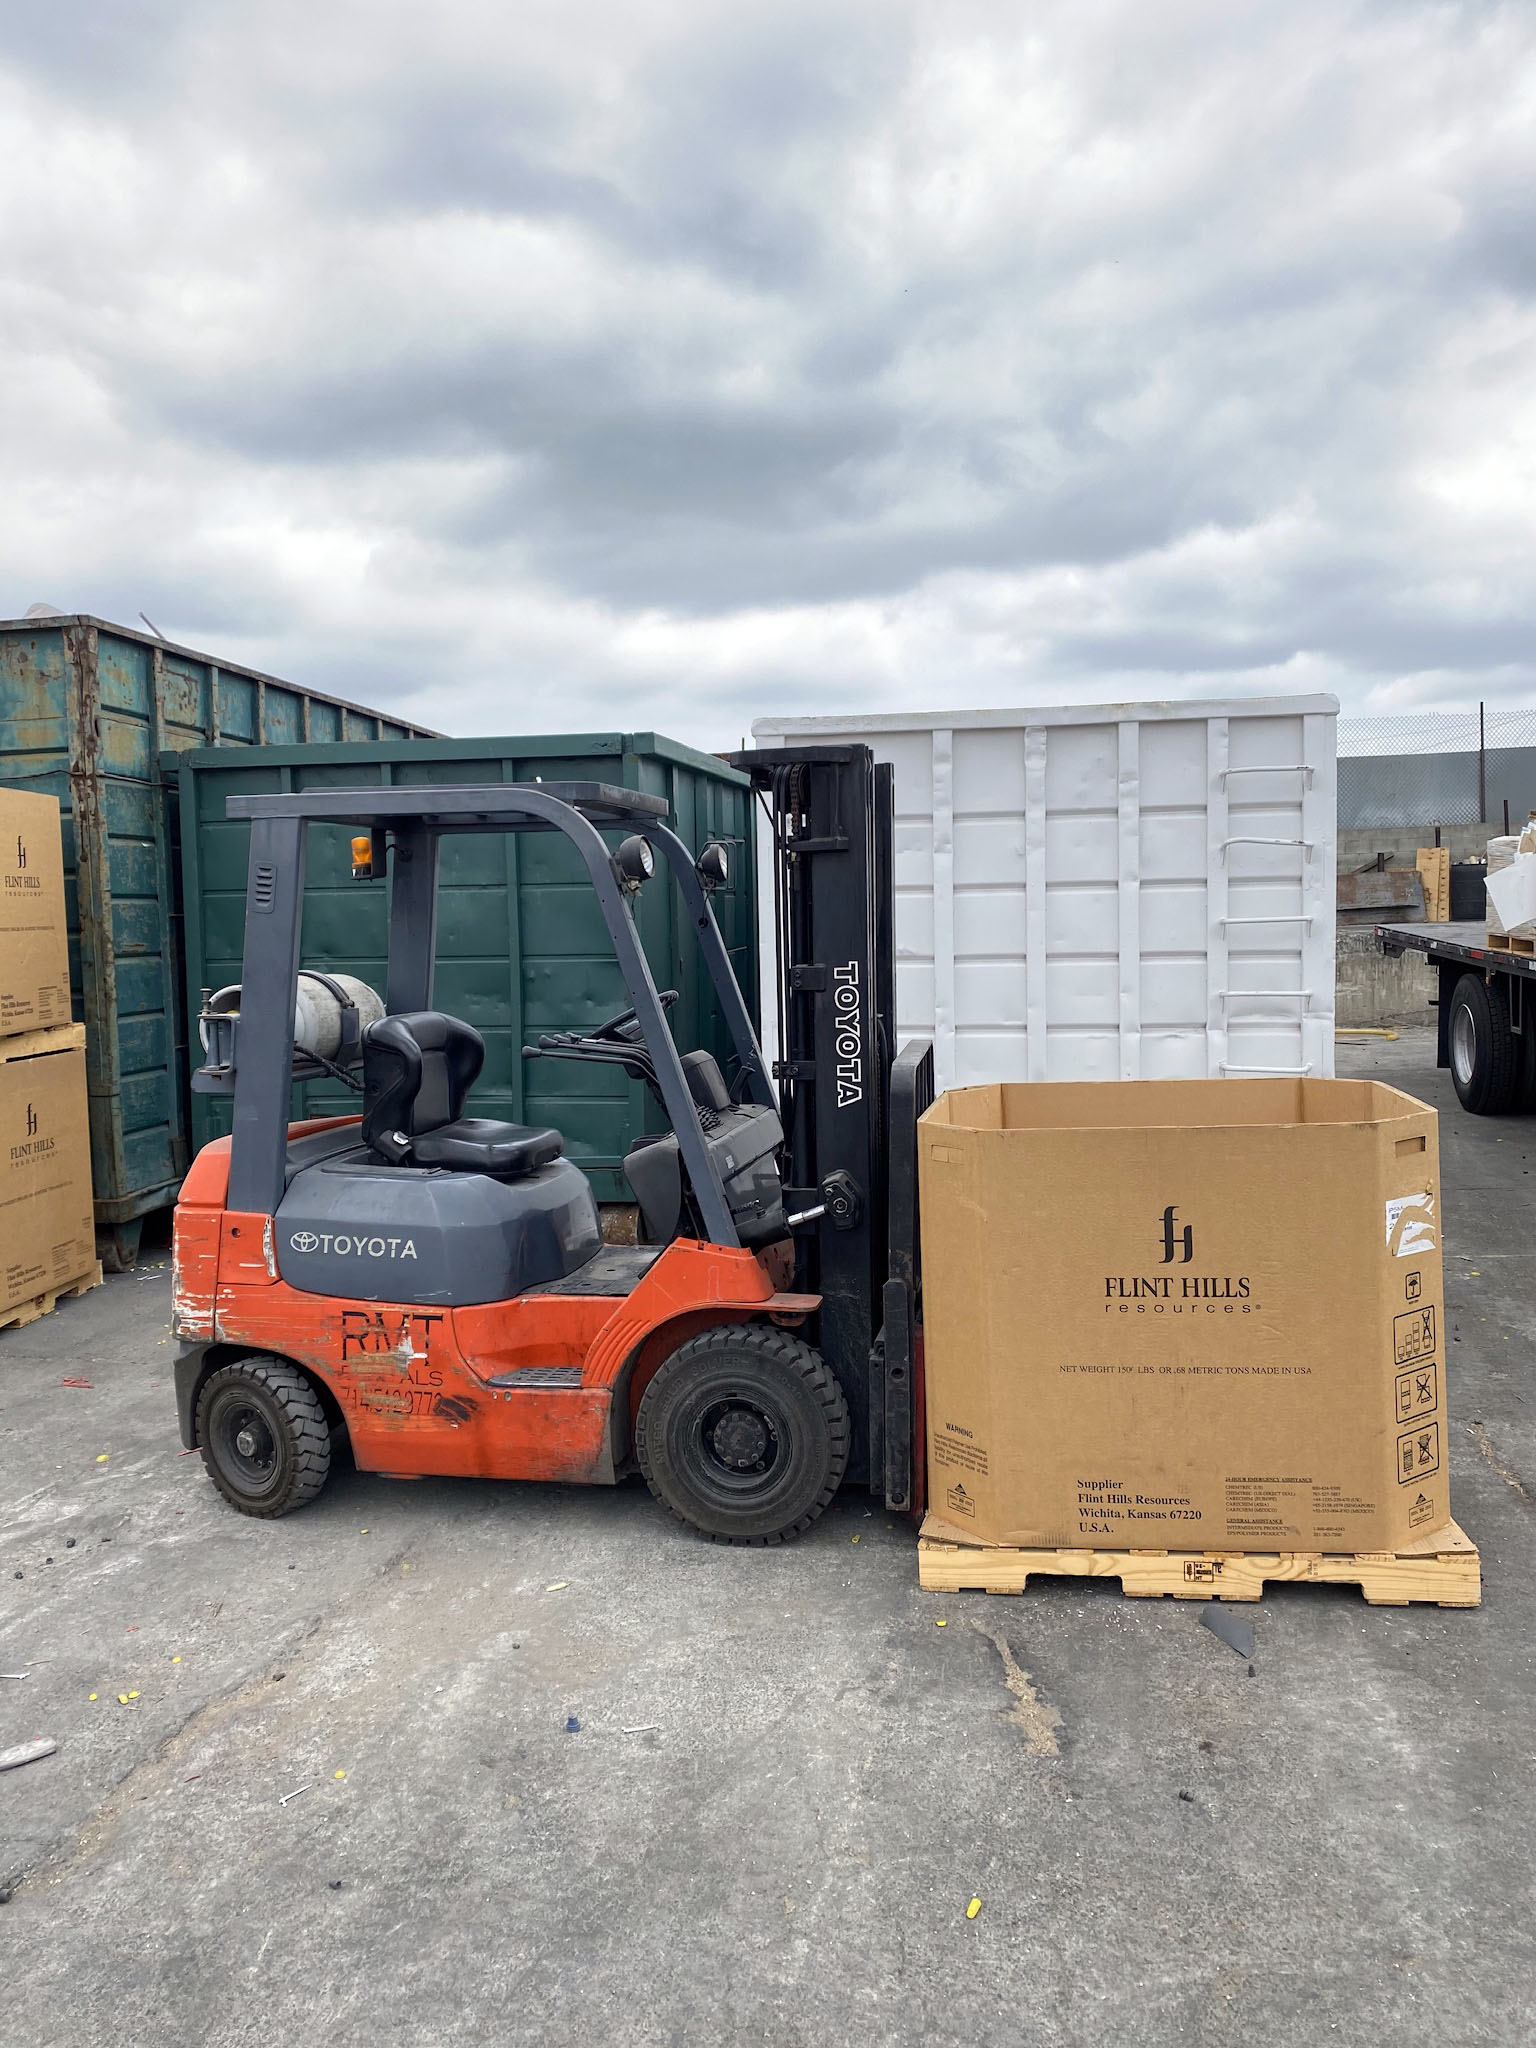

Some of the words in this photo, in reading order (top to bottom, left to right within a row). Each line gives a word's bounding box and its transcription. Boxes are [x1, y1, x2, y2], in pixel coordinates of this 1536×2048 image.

[4, 875, 22, 888] FLINT
[833, 960, 863, 1108] TOYOTA
[10, 1143, 32, 1160] FLINT
[33, 1137, 55, 1153] HILLS
[319, 1234, 418, 1260] TOYOTA
[1104, 1277, 1174, 1298] FLINT
[1180, 1277, 1250, 1298] HILLS
[1059, 1365, 1078, 1373] NET
[1079, 1365, 1115, 1374] WEIGHT
[1137, 1365, 1155, 1374] LBS
[1158, 1365, 1172, 1374] OR
[1188, 1366, 1223, 1374] METRIC
[1225, 1366, 1250, 1374] TONS
[1251, 1366, 1280, 1374] MADE
[1281, 1366, 1291, 1374] IN
[1294, 1366, 1312, 1374] USA
[945, 1422, 973, 1439] WARNING
[1077, 1479, 1124, 1491] Supplier
[1078, 1493, 1104, 1504] Flint
[1107, 1494, 1133, 1504] Hills
[1135, 1495, 1191, 1505] Resources
[1078, 1508, 1125, 1520] Wichita,
[1127, 1509, 1167, 1519] Kansas
[1169, 1510, 1202, 1520] 67220
[1079, 1522, 1114, 1533] U.S.A.
